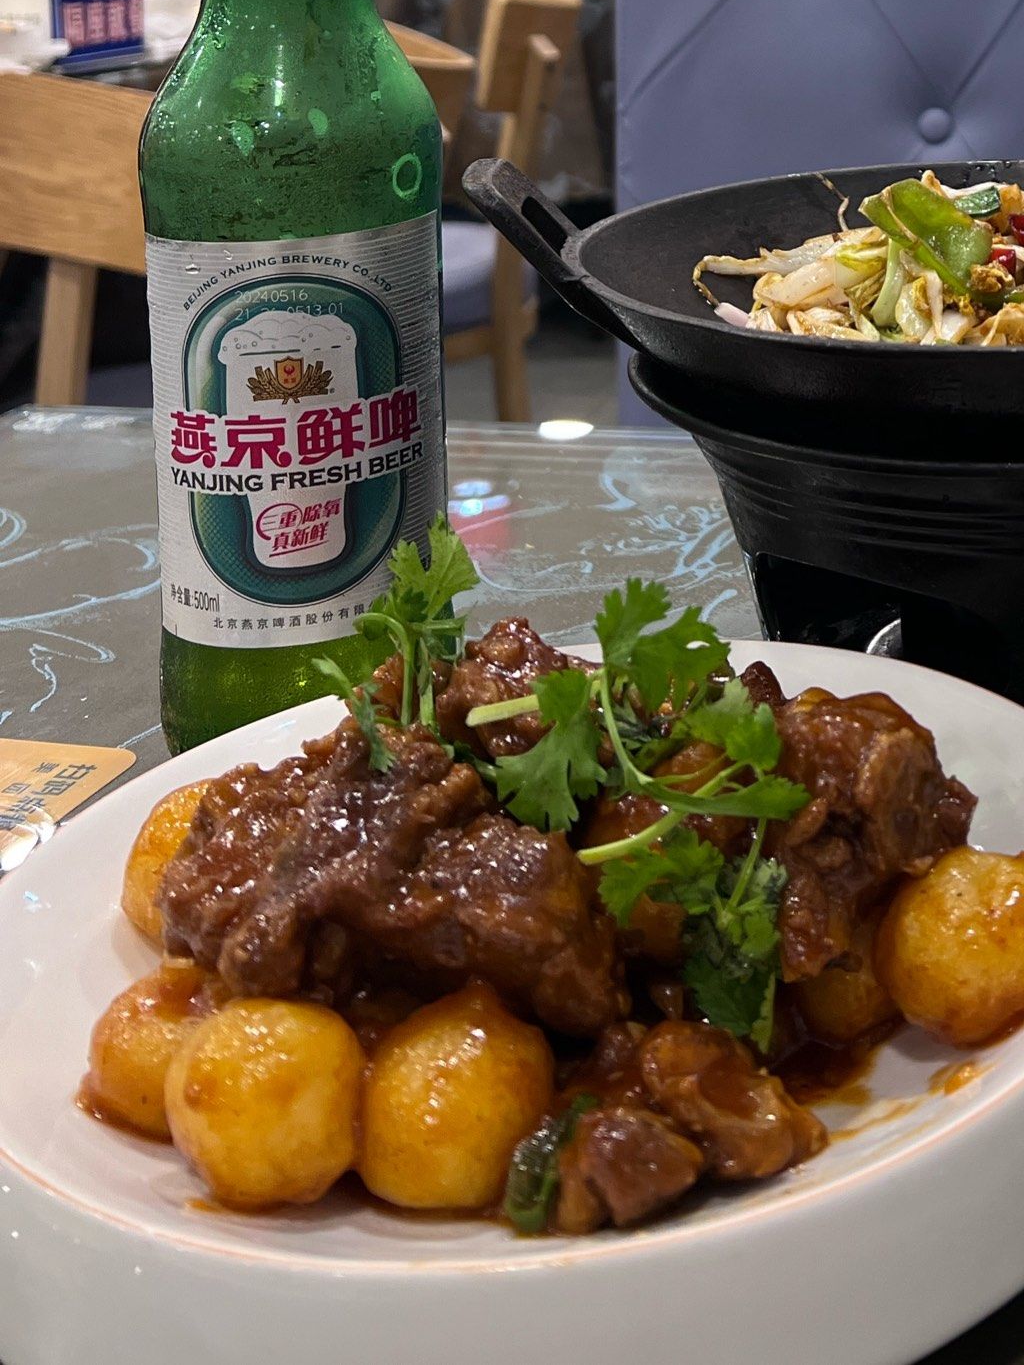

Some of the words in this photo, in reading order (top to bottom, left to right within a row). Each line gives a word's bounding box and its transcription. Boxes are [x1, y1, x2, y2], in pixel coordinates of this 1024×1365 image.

[183, 275, 219, 311] BEIJING
[220, 256, 277, 279] YANJING
[281, 255, 350, 269] BREWERY
[234, 288, 309, 303] 20240516
[170, 387, 422, 470] 燕京鲜啤
[170, 466, 264, 493] YANJING
[270, 461, 363, 492] FRESH
[368, 441, 423, 476] BEER
[262, 498, 342, 531] 三重除氧
[272, 521, 330, 551] 真新鲜
[213, 600, 374, 631] 北京燕京啤酒股份有限
